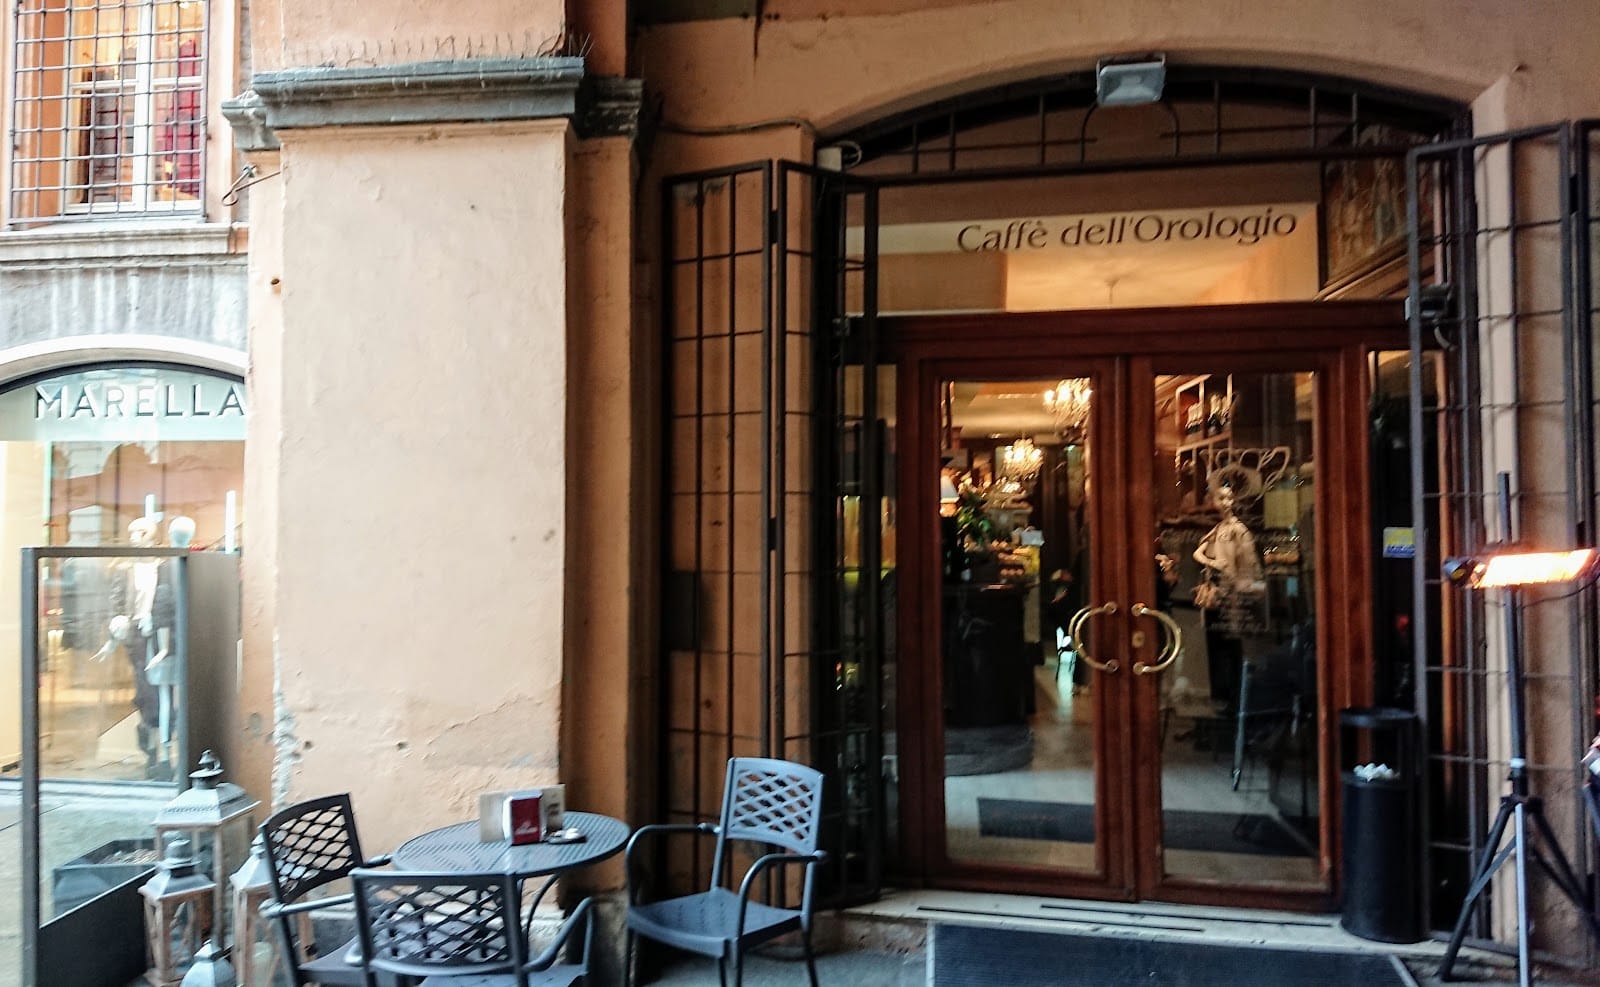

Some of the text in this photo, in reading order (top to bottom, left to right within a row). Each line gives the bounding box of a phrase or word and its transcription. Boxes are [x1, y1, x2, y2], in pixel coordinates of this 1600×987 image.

[957, 207, 1298, 252] Caffè dell'Orologio
[35, 384, 245, 419] MARELLA
